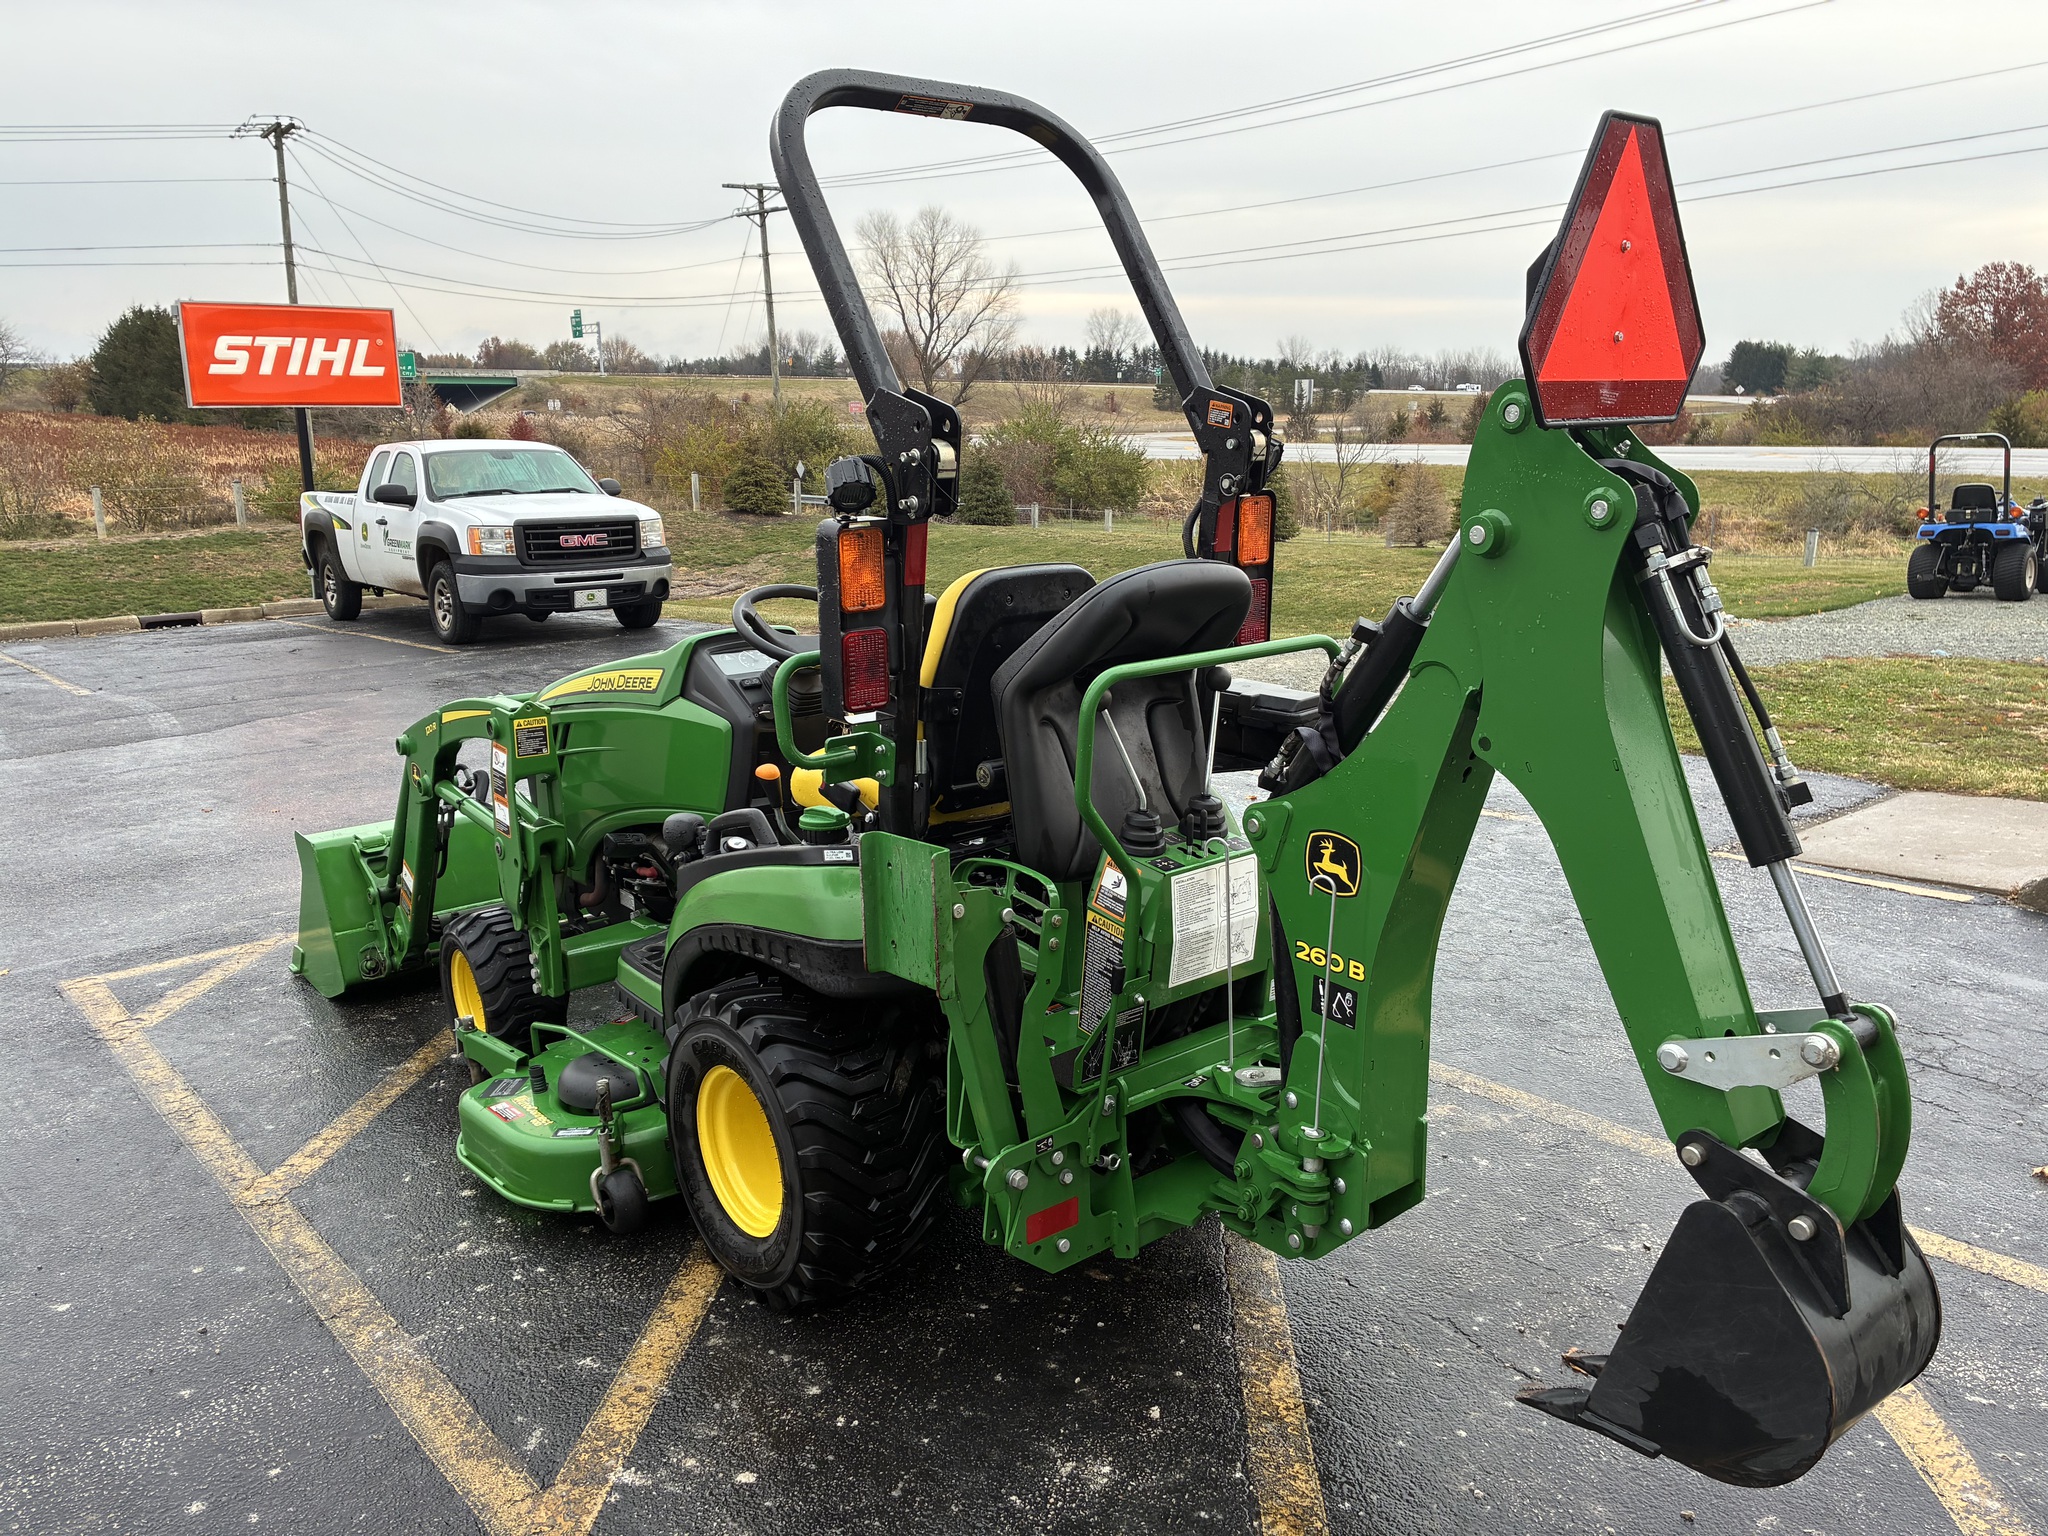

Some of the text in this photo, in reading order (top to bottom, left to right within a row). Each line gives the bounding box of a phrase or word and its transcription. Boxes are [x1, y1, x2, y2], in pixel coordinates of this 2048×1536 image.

[208, 335, 386, 377] STIHL
[560, 533, 608, 548] GMC
[587, 674, 654, 691] JOHN DEERE
[522, 718, 546, 727] CAUTION
[1098, 917, 1124, 937] CAUTION
[1295, 940, 1366, 981] 260 B
